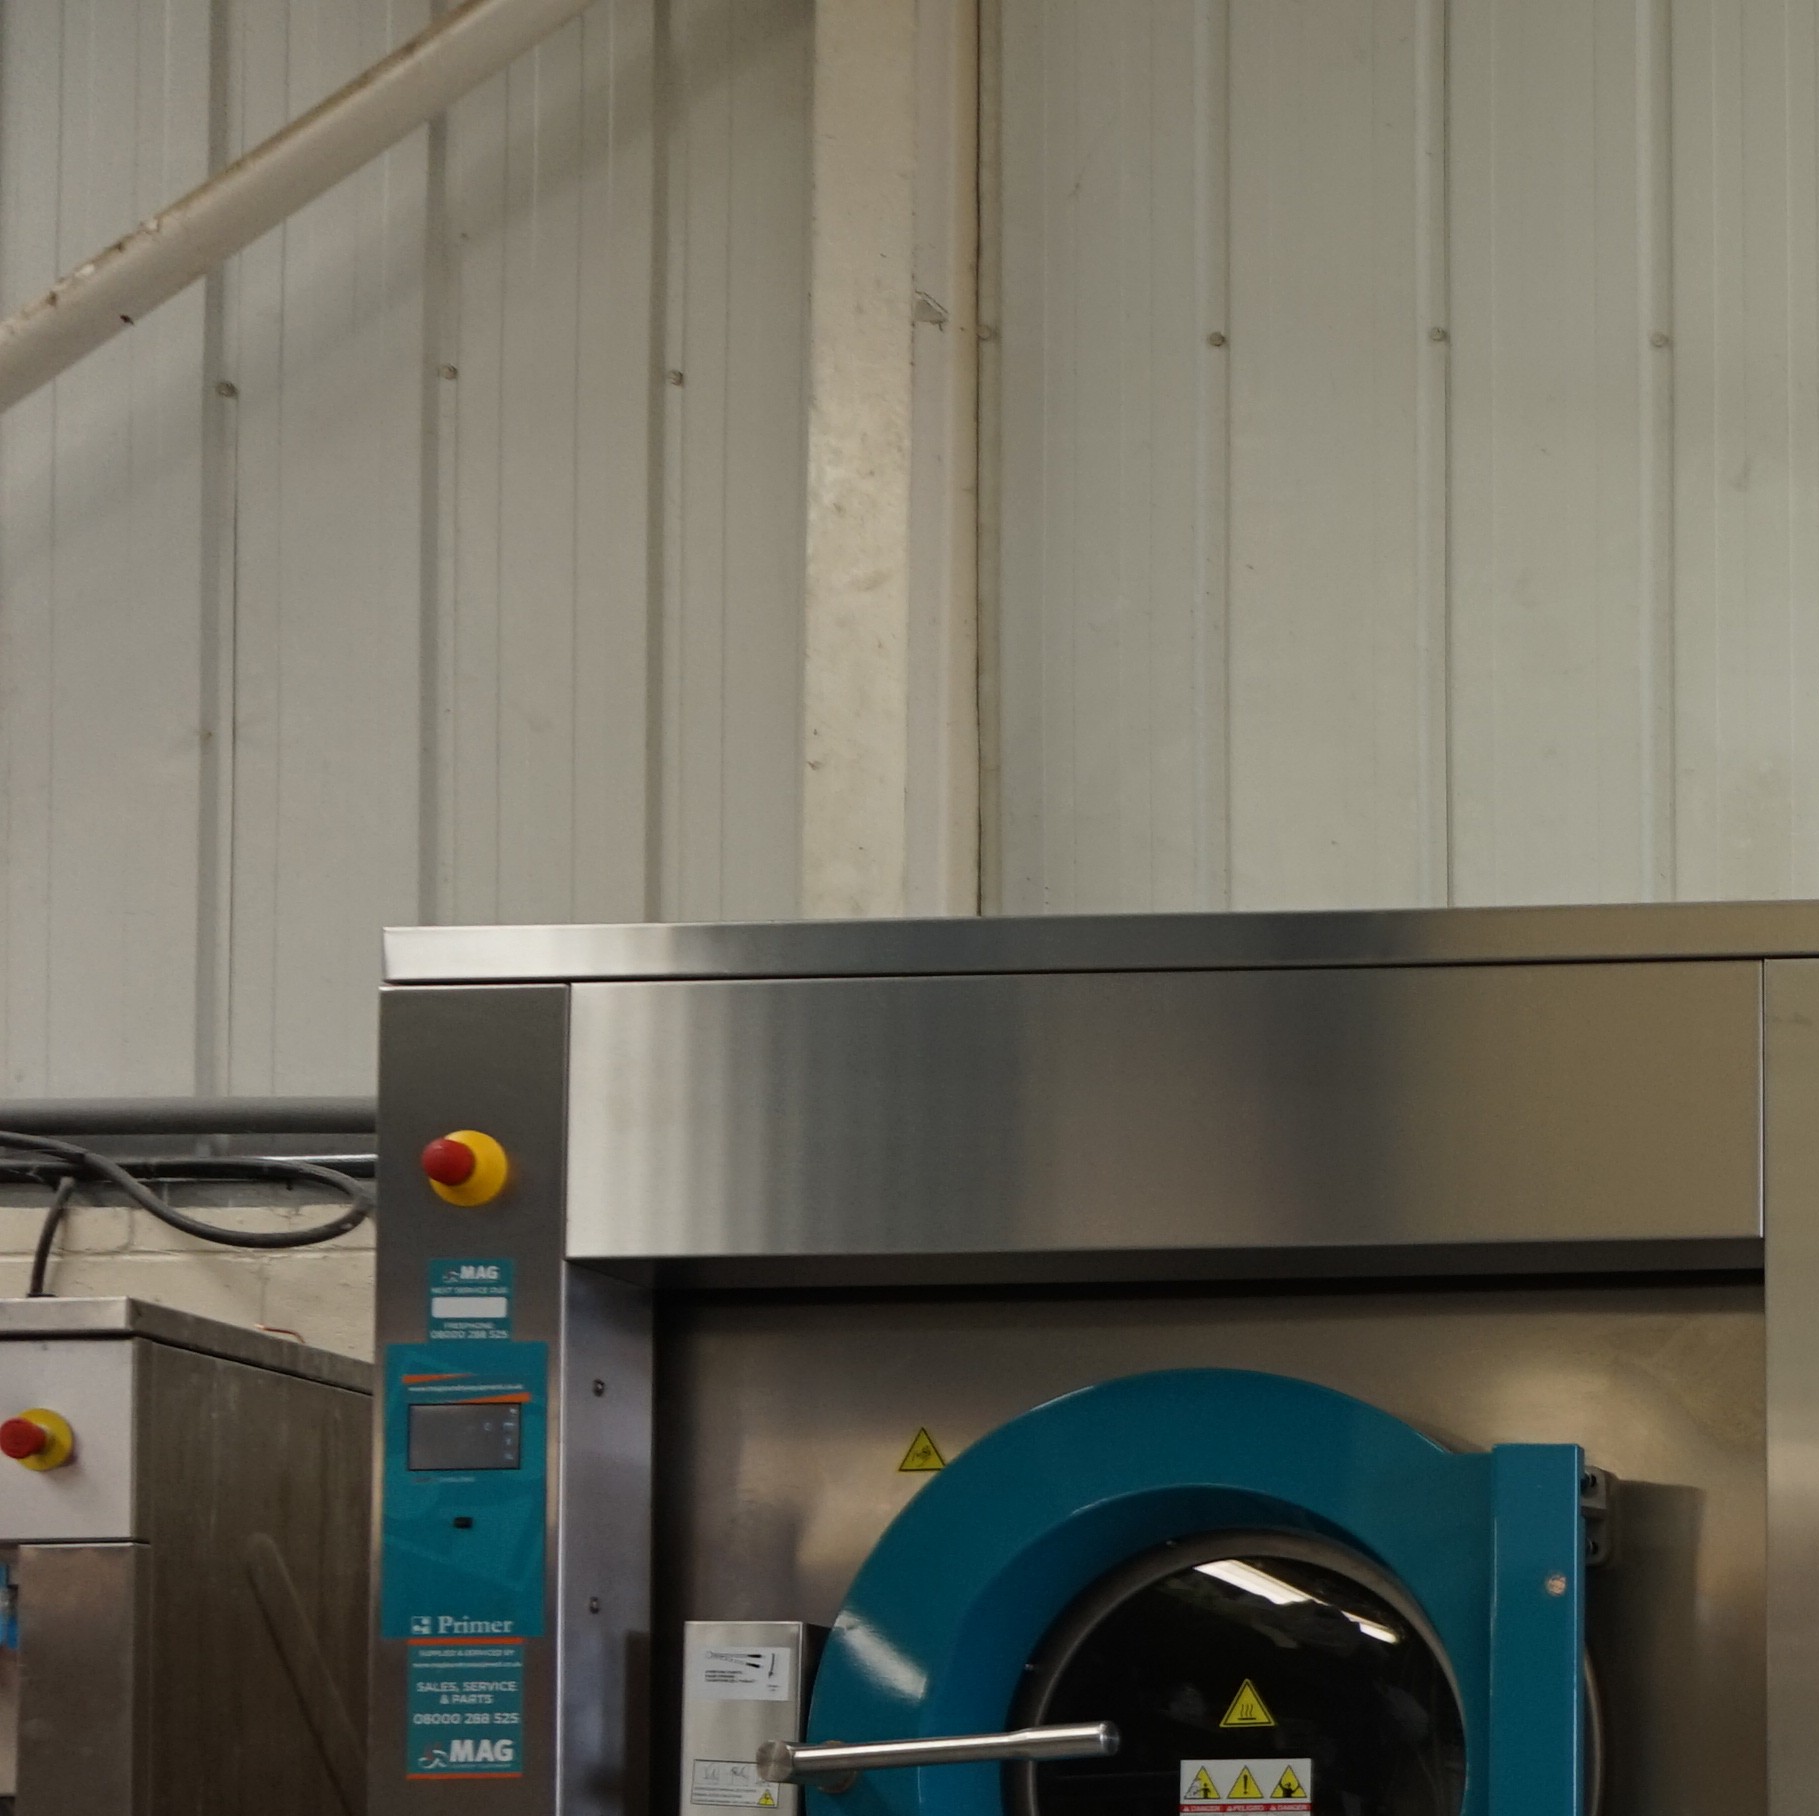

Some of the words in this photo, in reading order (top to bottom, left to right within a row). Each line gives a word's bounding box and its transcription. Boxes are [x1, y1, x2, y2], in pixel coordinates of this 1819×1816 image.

[460, 1265, 500, 1279] MAG
[437, 1615, 514, 1634] Primer
[463, 1681, 519, 1692] SERVICE
[452, 1694, 494, 1704] PARTS
[413, 1713, 461, 1725] 08000
[464, 1713, 490, 1724] 288
[493, 1712, 519, 1724] 525
[450, 1738, 514, 1763] MAG
